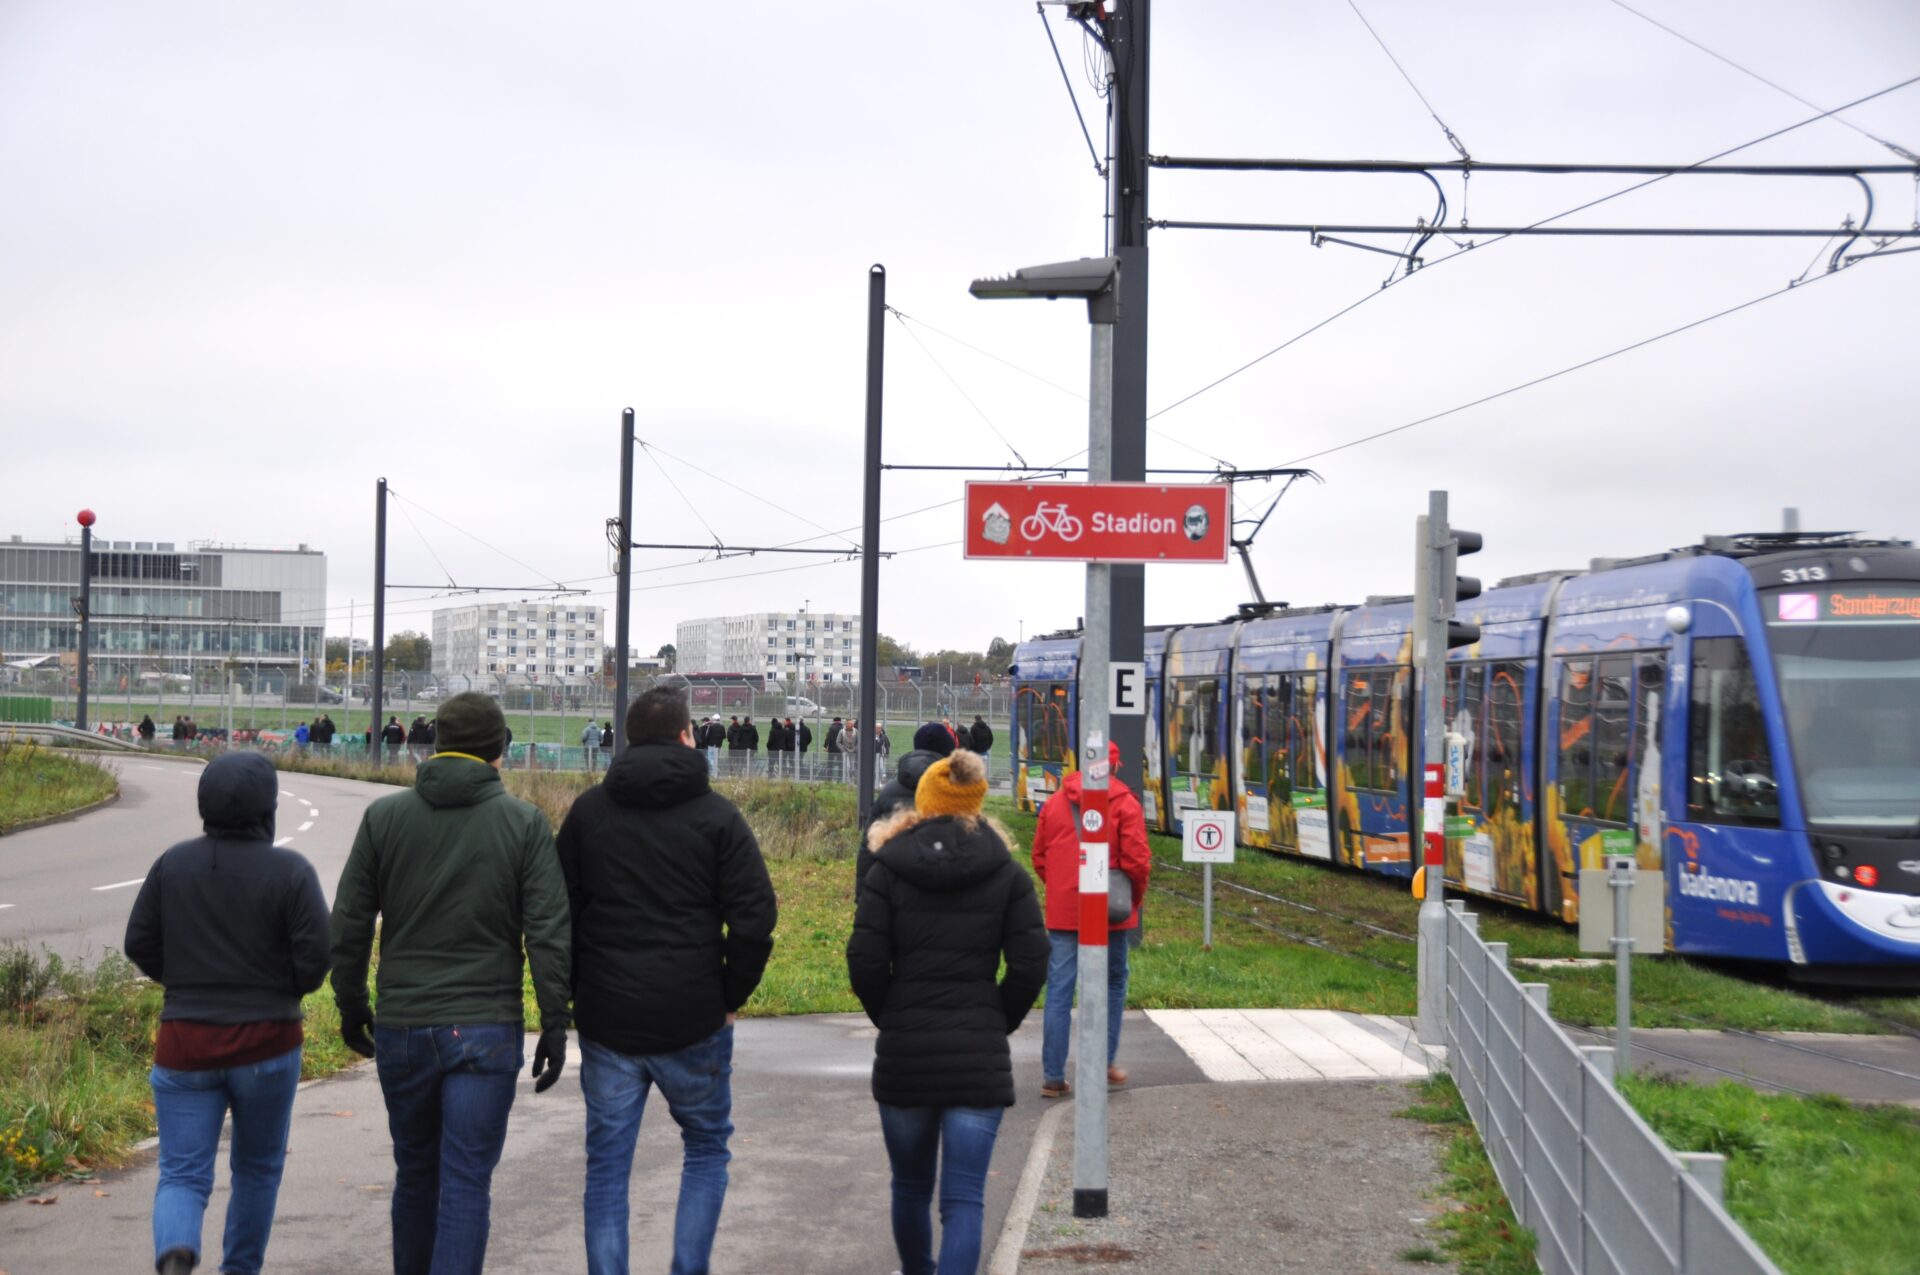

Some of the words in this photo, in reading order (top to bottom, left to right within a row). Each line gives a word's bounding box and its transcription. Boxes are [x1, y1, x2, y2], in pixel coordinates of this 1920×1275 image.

[1091, 512, 1176, 534] Stadion
[1780, 566, 1826, 583] 313
[1830, 593, 1920, 618] Sonderzug
[1116, 669, 1135, 708] E
[1678, 862, 1759, 906] badenova
